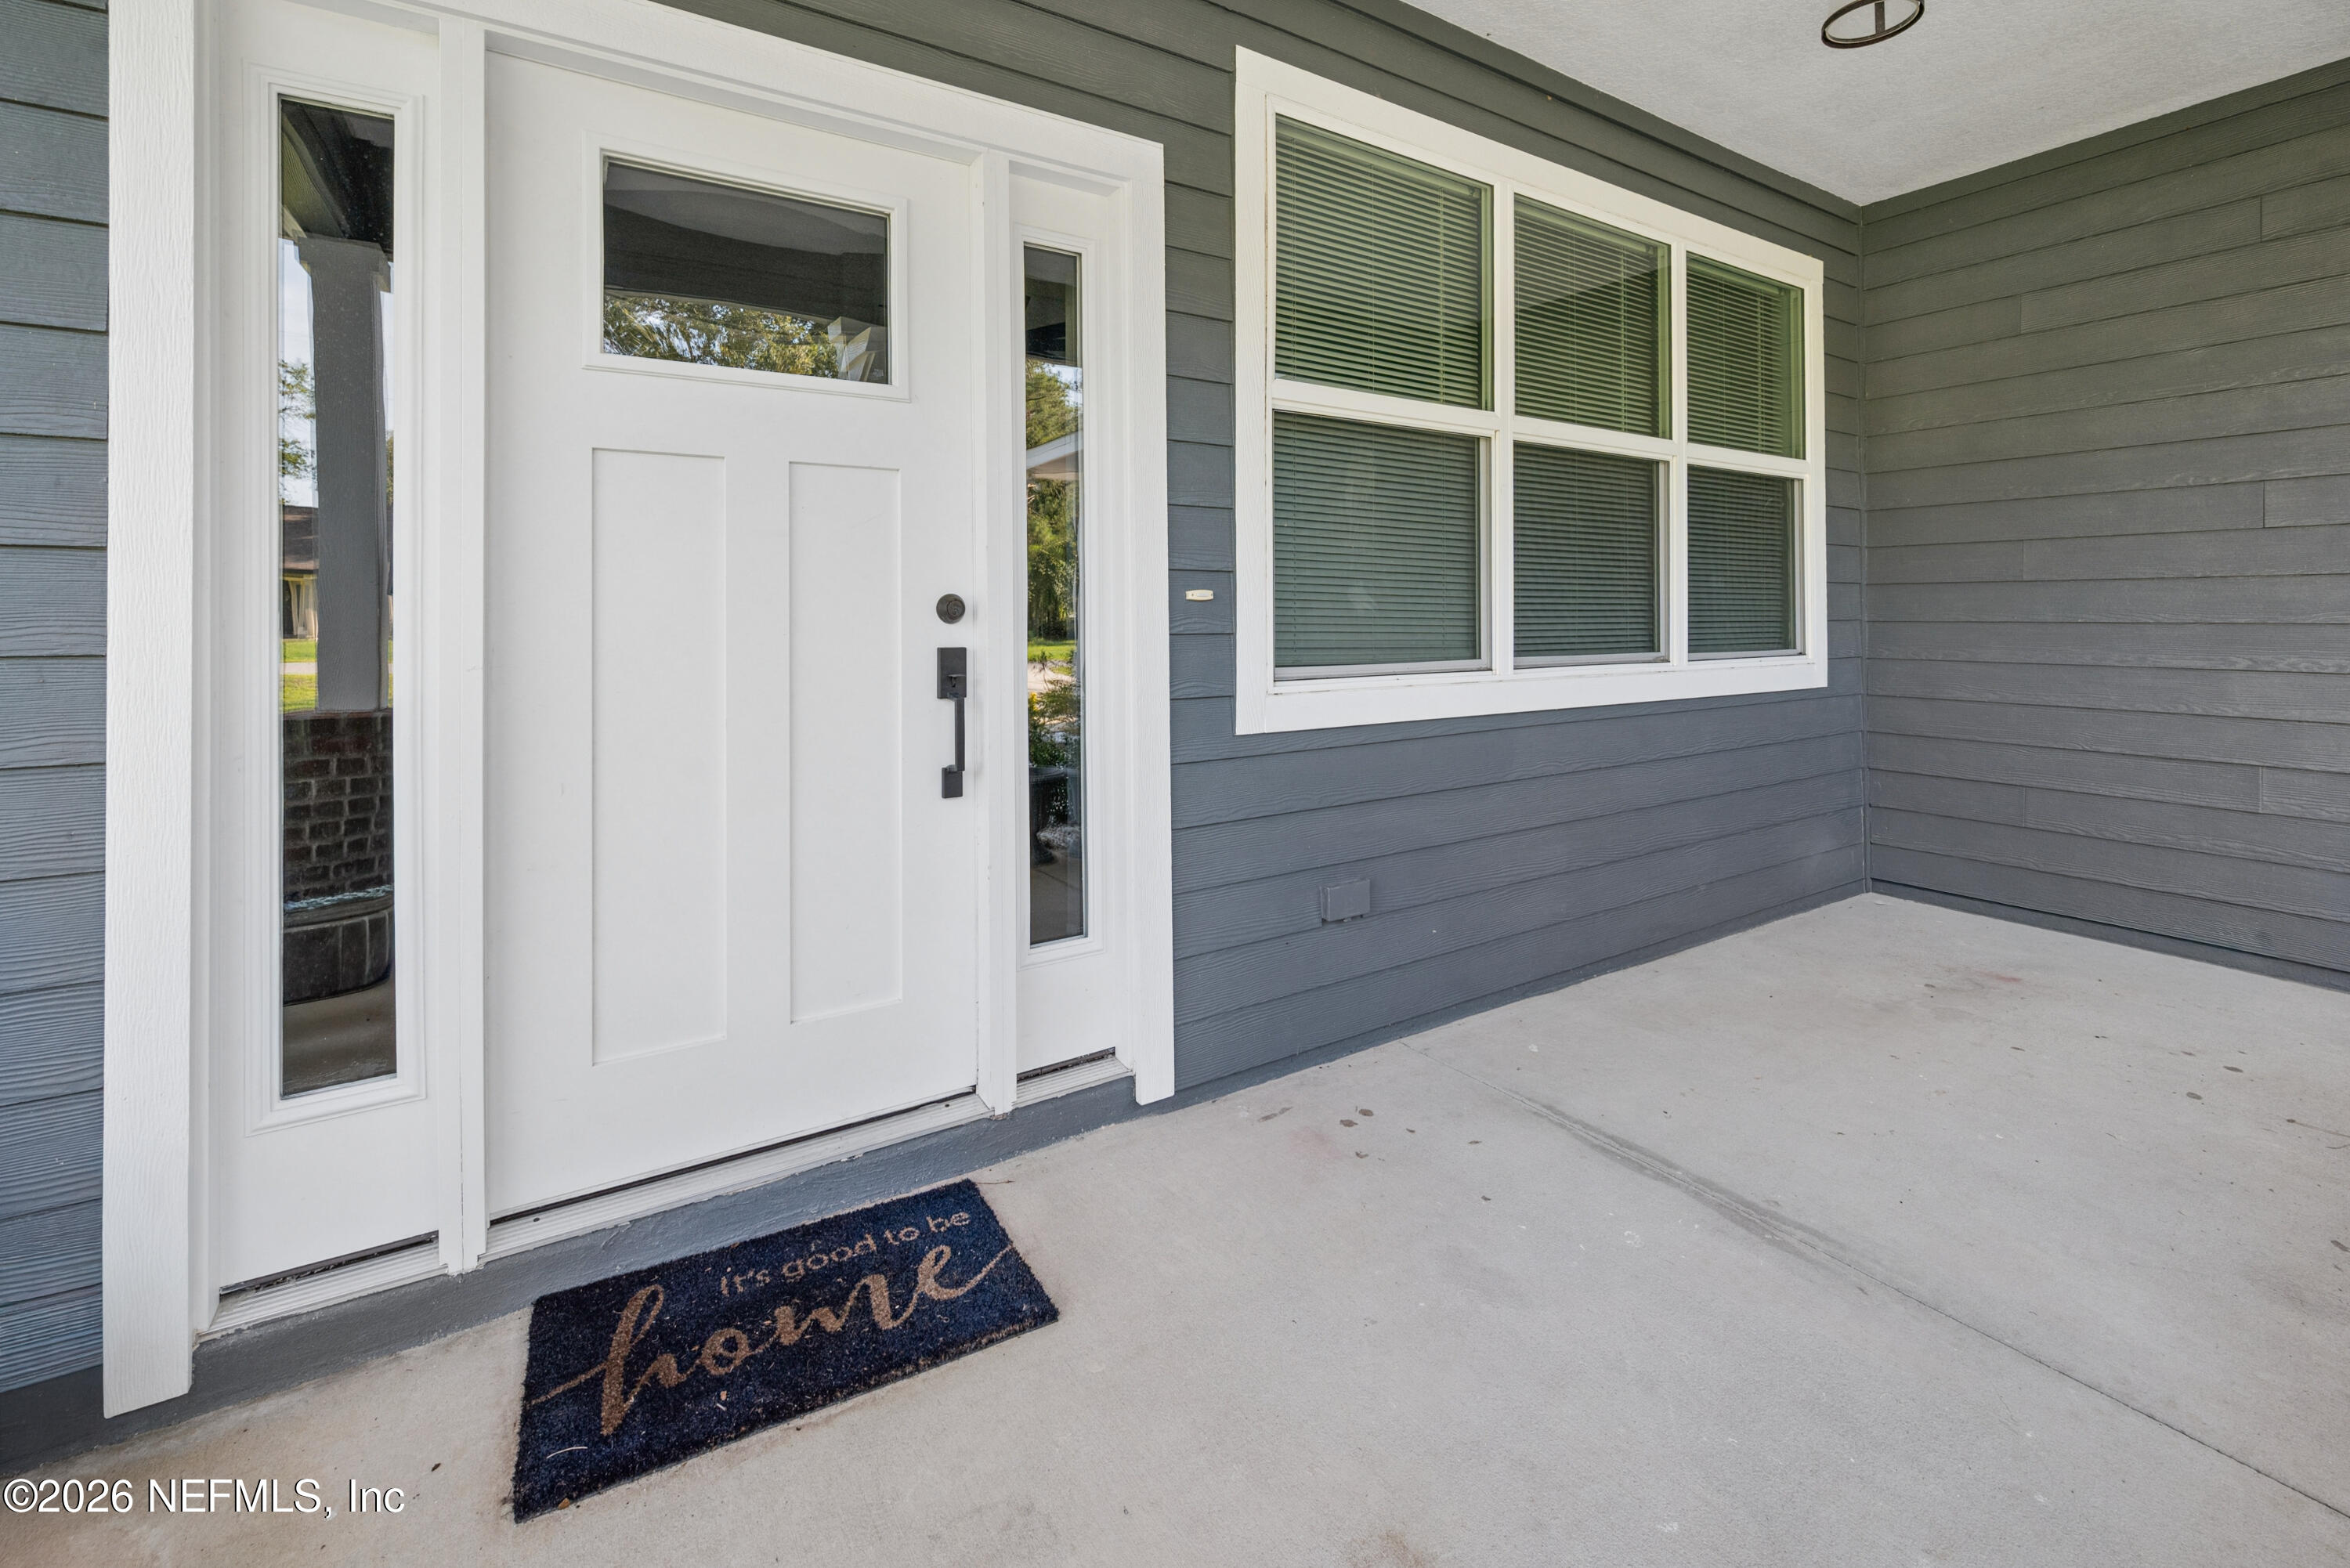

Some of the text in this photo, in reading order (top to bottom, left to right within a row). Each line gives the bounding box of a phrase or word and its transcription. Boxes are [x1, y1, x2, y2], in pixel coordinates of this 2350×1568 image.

[783, 1233, 877, 1283] good
[884, 1227, 920, 1245] to
[926, 1212, 970, 1233] be
[530, 1244, 1015, 1436] home
